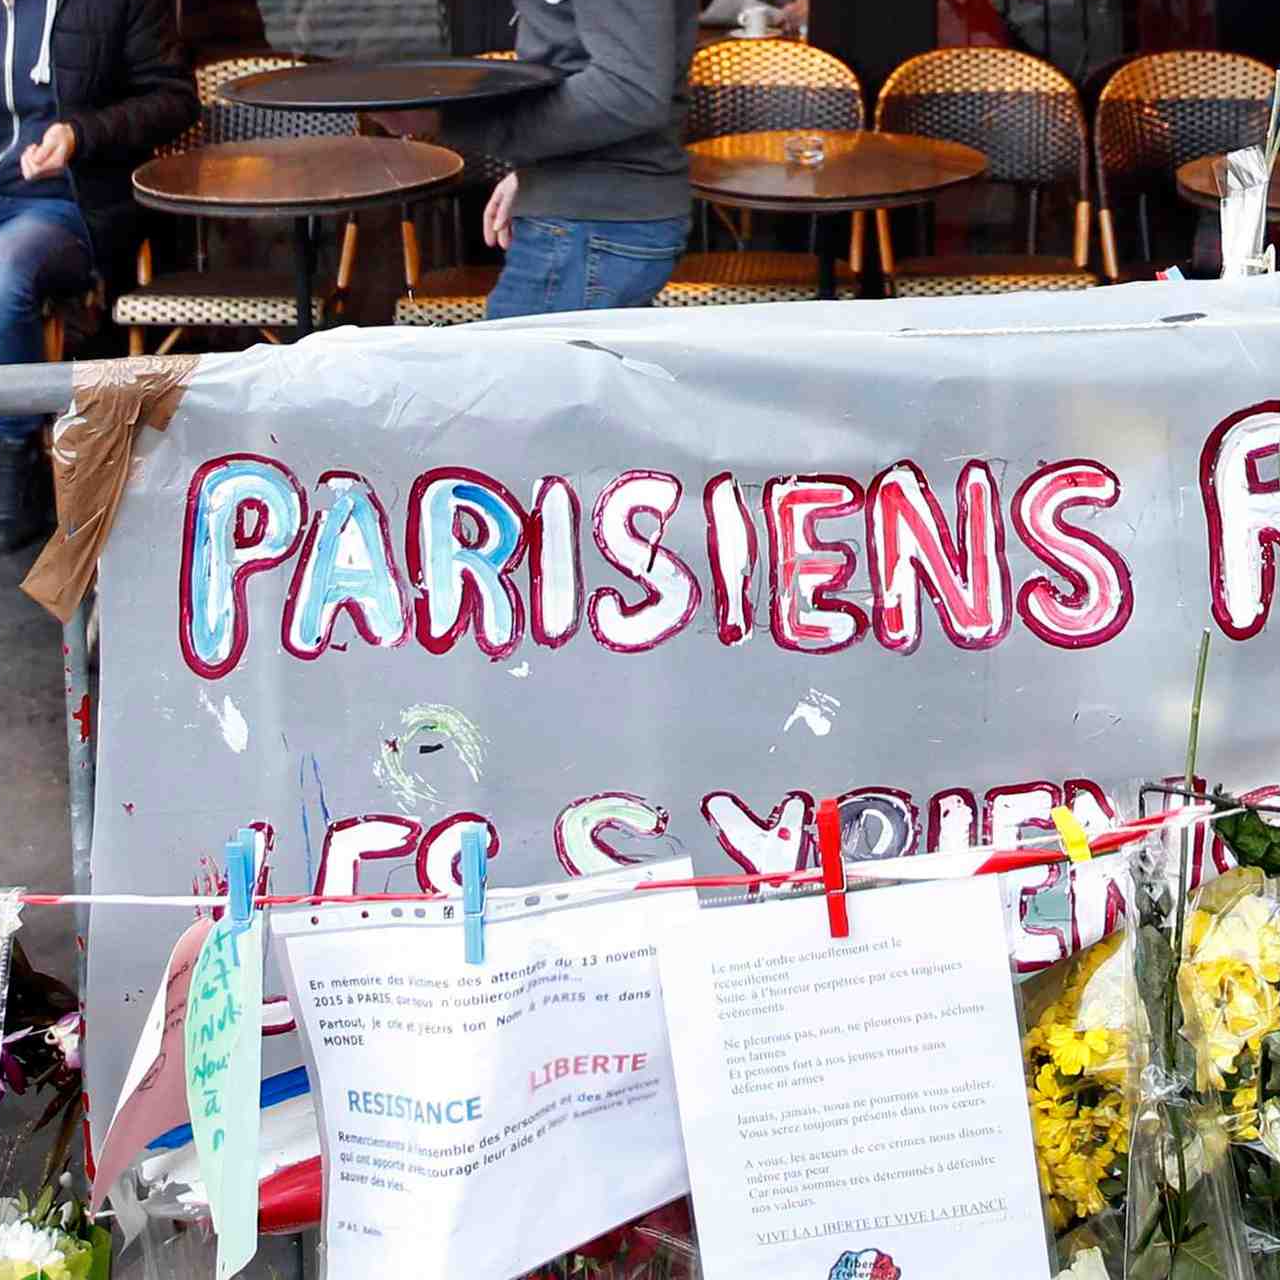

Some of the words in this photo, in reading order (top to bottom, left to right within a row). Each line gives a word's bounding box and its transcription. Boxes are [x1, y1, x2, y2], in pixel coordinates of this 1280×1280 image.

[178, 449, 1136, 681] PARISIENS
[891, 937, 903, 949] le
[581, 954, 598, 967] 13
[869, 971, 887, 986] par
[889, 967, 909, 980] ces
[313, 994, 344, 1008] 2015
[543, 991, 586, 1006] PARIS
[595, 991, 609, 1002] et
[618, 989, 652, 1002] dans
[323, 1034, 366, 1048] MONDE
[723, 1037, 741, 1051] Ne
[743, 1030, 792, 1050] pleurons
[847, 1021, 862, 1032] ne
[863, 1013, 913, 1033] pleurons
[726, 1053, 746, 1065] nos
[748, 1048, 787, 1062] larmes
[745, 1062, 790, 1082] pensons
[792, 1056, 813, 1071] fort
[825, 1054, 846, 1066] nos
[847, 1048, 885, 1066] jeunes
[886, 1044, 919, 1058] morts
[921, 1040, 947, 1052] sans
[528, 1051, 648, 1094] LIBERTE
[347, 1089, 483, 1125] RESISTANCE
[823, 1100, 851, 1113] nous
[853, 1098, 868, 1109] ne
[922, 1086, 950, 1098] vous
[739, 1128, 769, 1141] Vous
[770, 1123, 802, 1136] serez
[803, 1115, 850, 1132] toujours
[900, 1104, 928, 1118] dans
[929, 1102, 949, 1113] nos
[479, 1133, 501, 1150] des
[744, 1158, 754, 1170] A
[790, 1150, 807, 1164] les
[851, 1142, 865, 1155] de
[867, 1141, 887, 1153] ces
[928, 1131, 956, 1144] nous
[782, 1168, 801, 1182] pas
[748, 1187, 769, 1200] Car
[771, 1183, 800, 1195] nous
[800, 1177, 848, 1192] sommes
[751, 1204, 772, 1216] nos
[756, 1231, 789, 1245] VIVE
[792, 1227, 811, 1240] LA
[814, 1218, 872, 1237] LIBERTE
[874, 1214, 891, 1228] ET
[894, 1209, 928, 1225] VIVE
[930, 1206, 949, 1220] LA
[951, 1197, 1008, 1217] FRANCE
